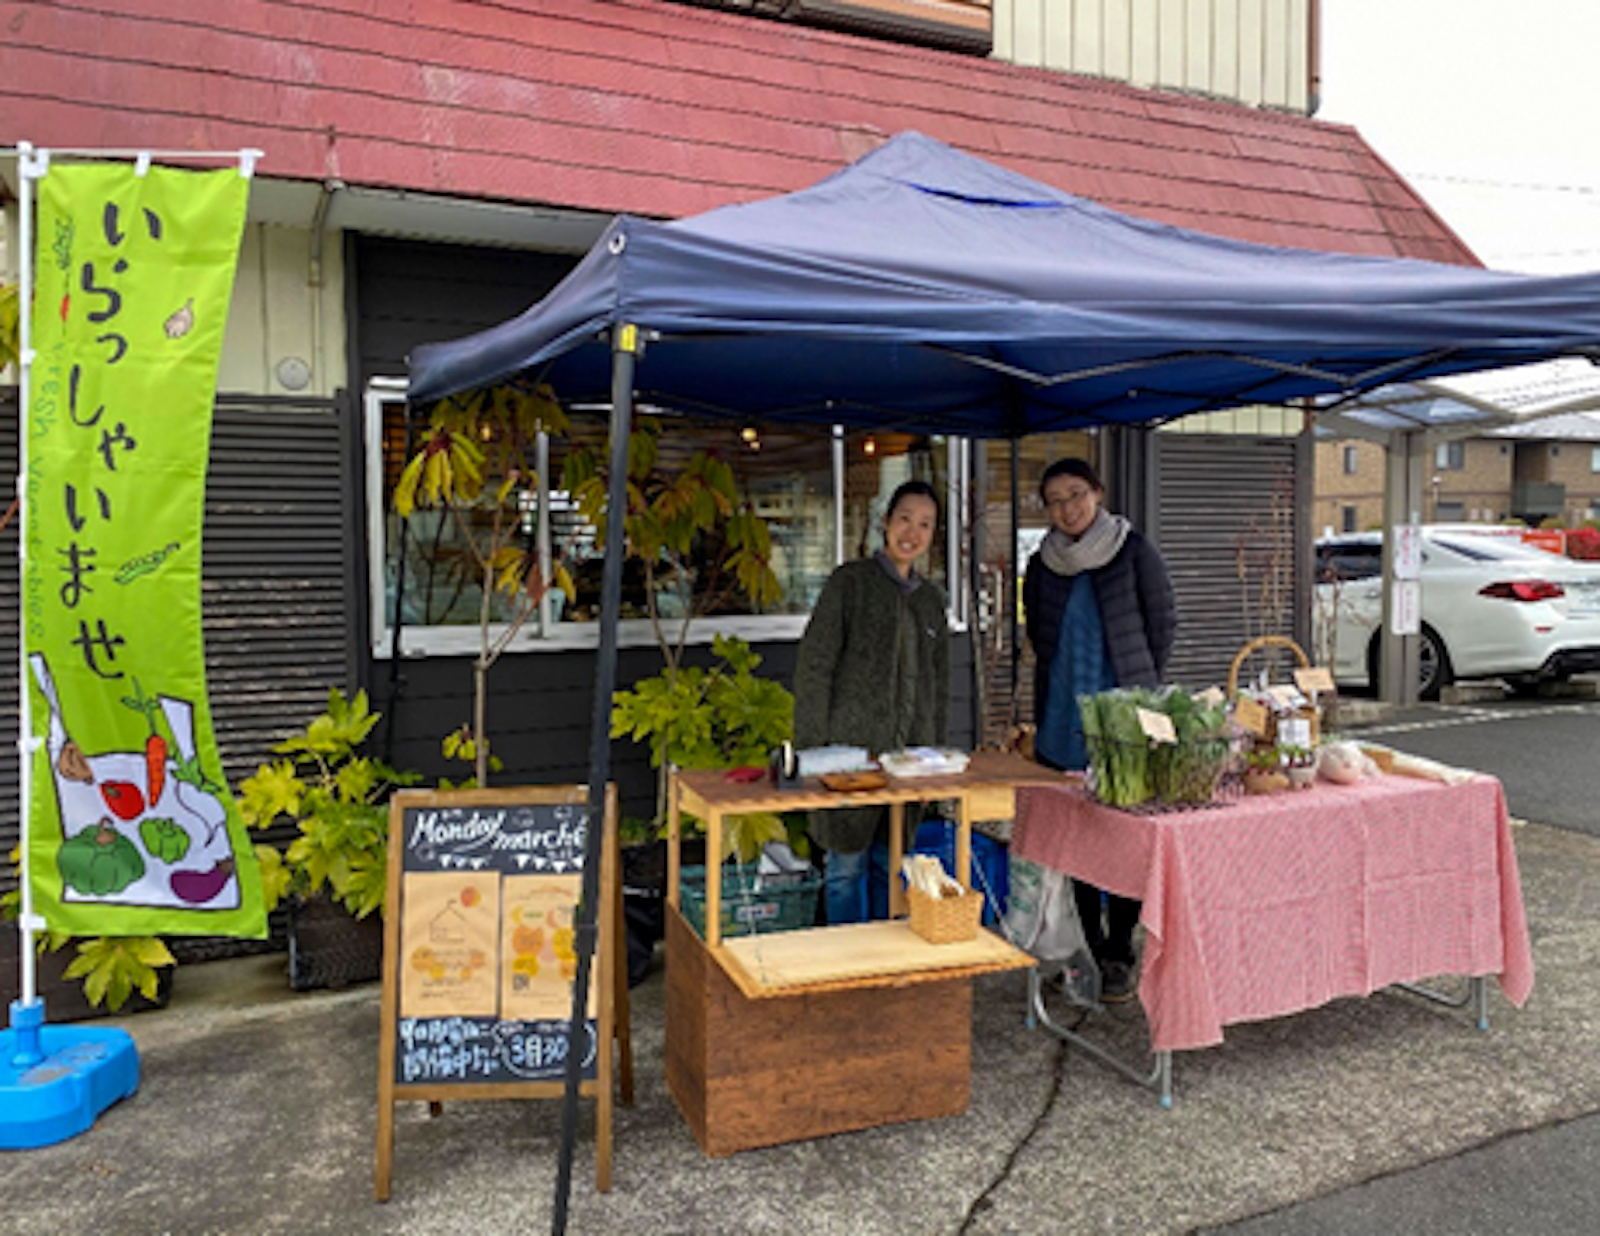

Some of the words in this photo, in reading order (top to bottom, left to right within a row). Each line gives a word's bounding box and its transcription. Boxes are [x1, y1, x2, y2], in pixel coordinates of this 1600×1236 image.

[58, 202, 162, 678] いらっしゃいませ
[408, 810, 505, 852] Monday
